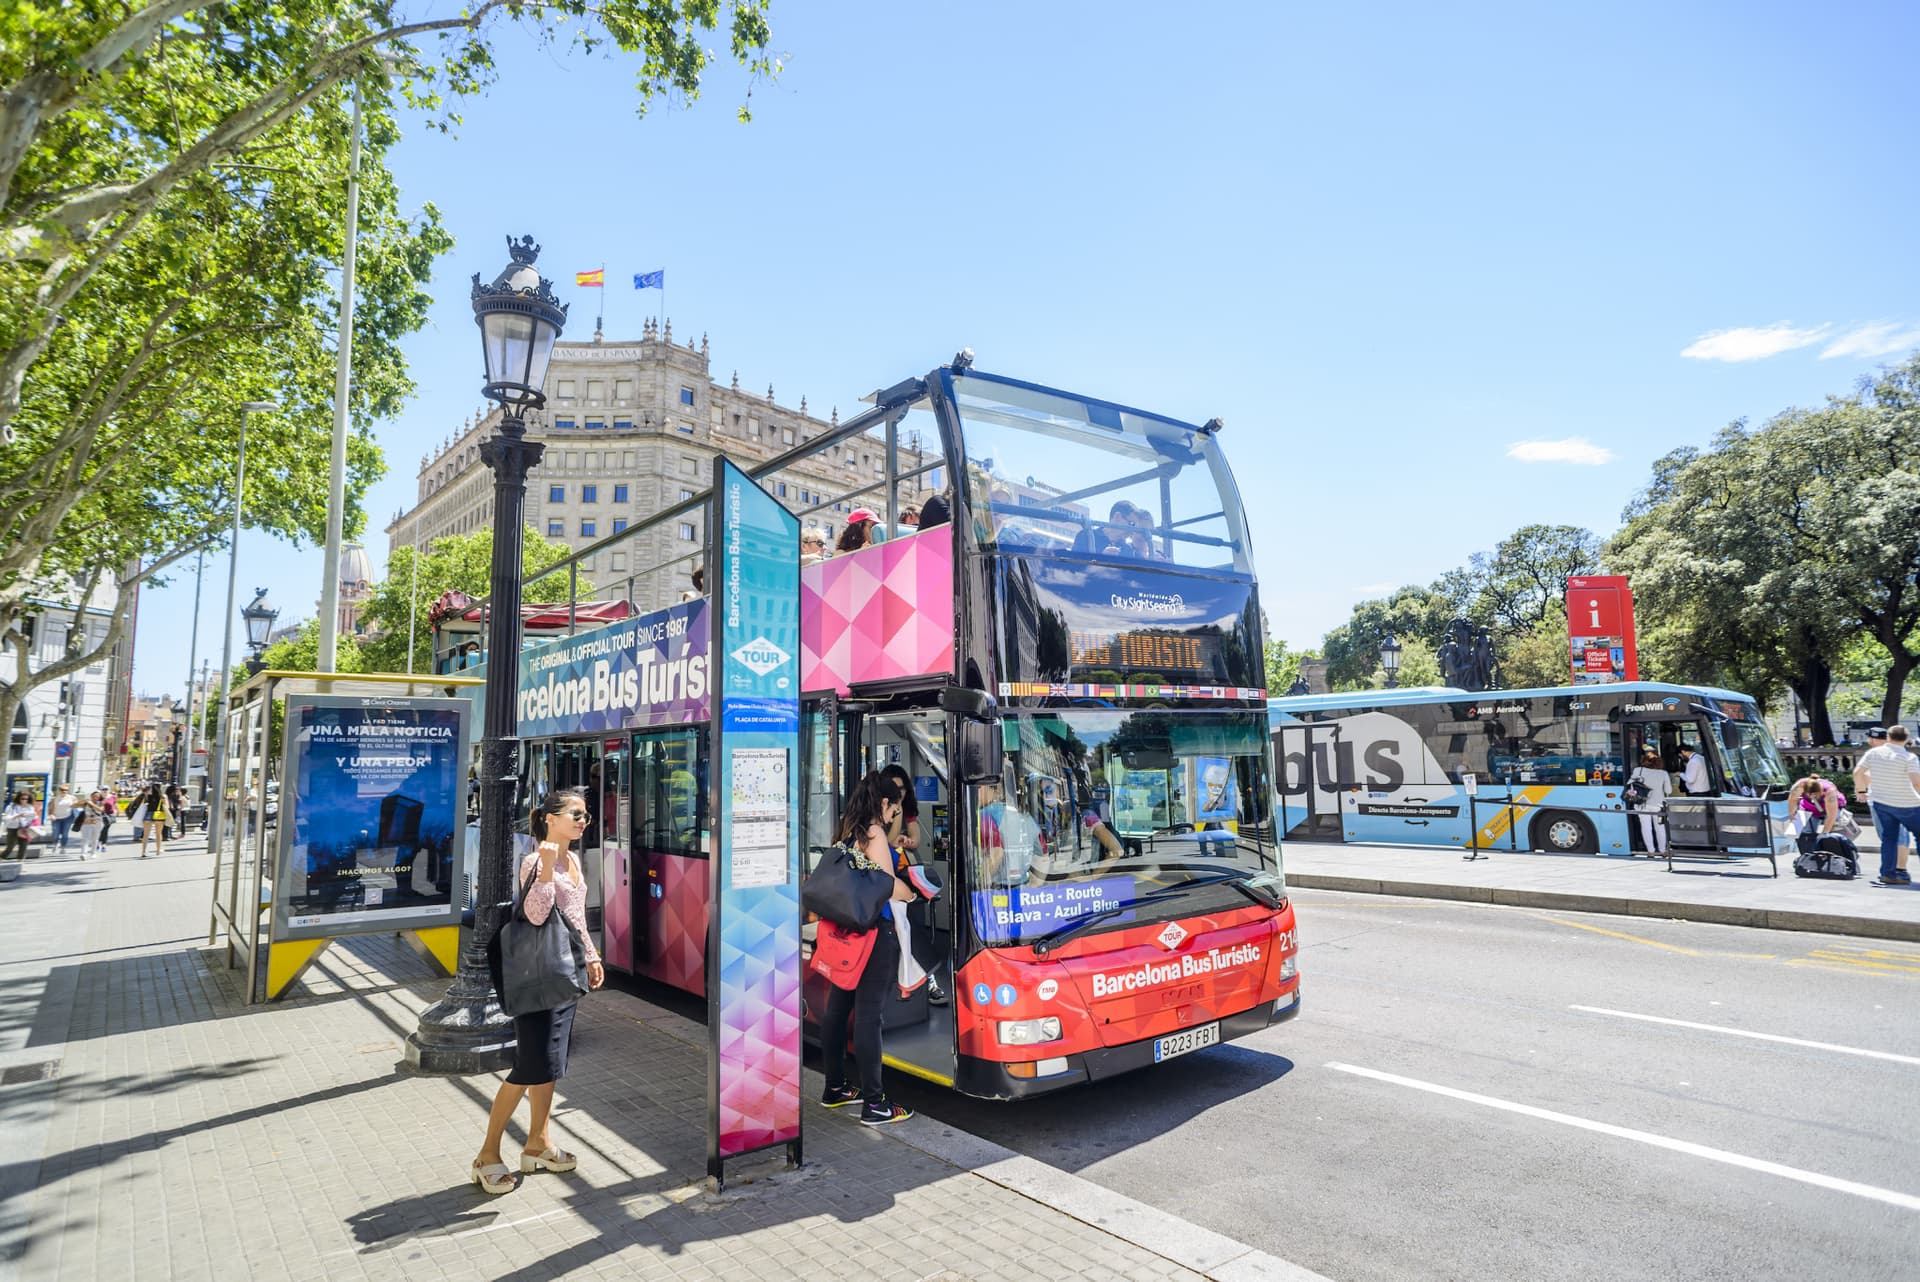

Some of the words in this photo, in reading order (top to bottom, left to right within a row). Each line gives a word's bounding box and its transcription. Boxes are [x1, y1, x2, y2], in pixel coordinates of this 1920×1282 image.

[553, 350, 588, 358] BANCO
[728, 557, 740, 628] Barcelona
[529, 658, 541, 673] THE
[540, 655, 571, 670] ORIGINAL
[577, 641, 611, 660] OFFICIAL
[611, 631, 635, 650] TOUR
[637, 622, 665, 645] SINCE
[665, 616, 688, 638] 1987
[1119, 633, 1203, 668] TURISTIC
[742, 650, 780, 664] TOUR
[517, 672, 591, 722] rcelona
[1625, 703, 1646, 712] Free
[310, 725, 343, 736] UNA
[347, 725, 394, 737] MALA
[394, 727, 453, 738] NOTICIA
[335, 757, 346, 767] Y
[350, 757, 383, 767] UNA
[336, 867, 382, 876] ¿HACEMOS
[384, 865, 412, 873] ALGO?
[1020, 891, 1054, 906] Ruta
[1066, 886, 1102, 901] Route
[997, 911, 1042, 925] Blava
[1054, 902, 1082, 919] Azul
[1092, 899, 1120, 914] Blue
[1164, 931, 1181, 941] TOUR
[1093, 961, 1181, 997] Barcelona
[1162, 1035, 1192, 1057] 9223
[1195, 1025, 1217, 1046] FBT
